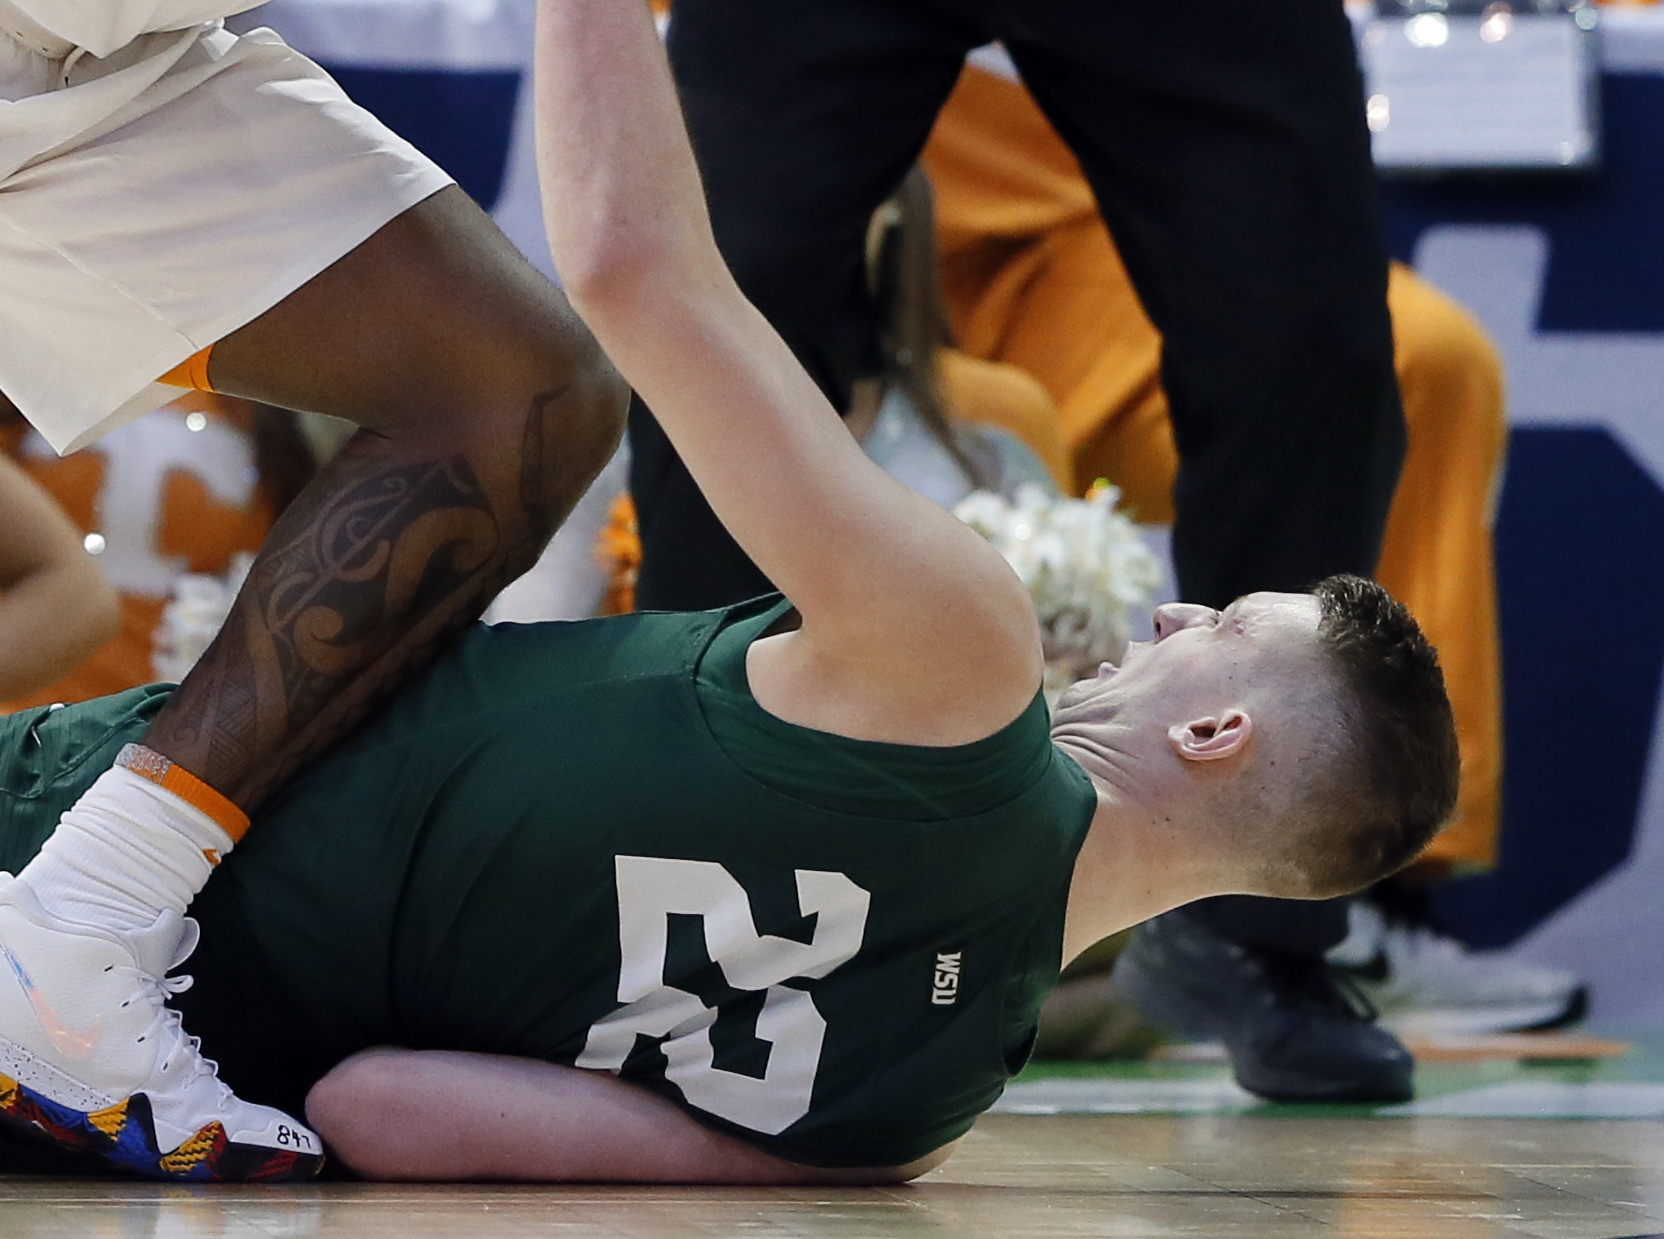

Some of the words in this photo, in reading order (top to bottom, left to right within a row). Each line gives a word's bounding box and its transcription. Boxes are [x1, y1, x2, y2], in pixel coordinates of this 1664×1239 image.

[574, 854, 872, 1136] 22
[931, 950, 962, 1006] WSU
[276, 1124, 311, 1149] 847
